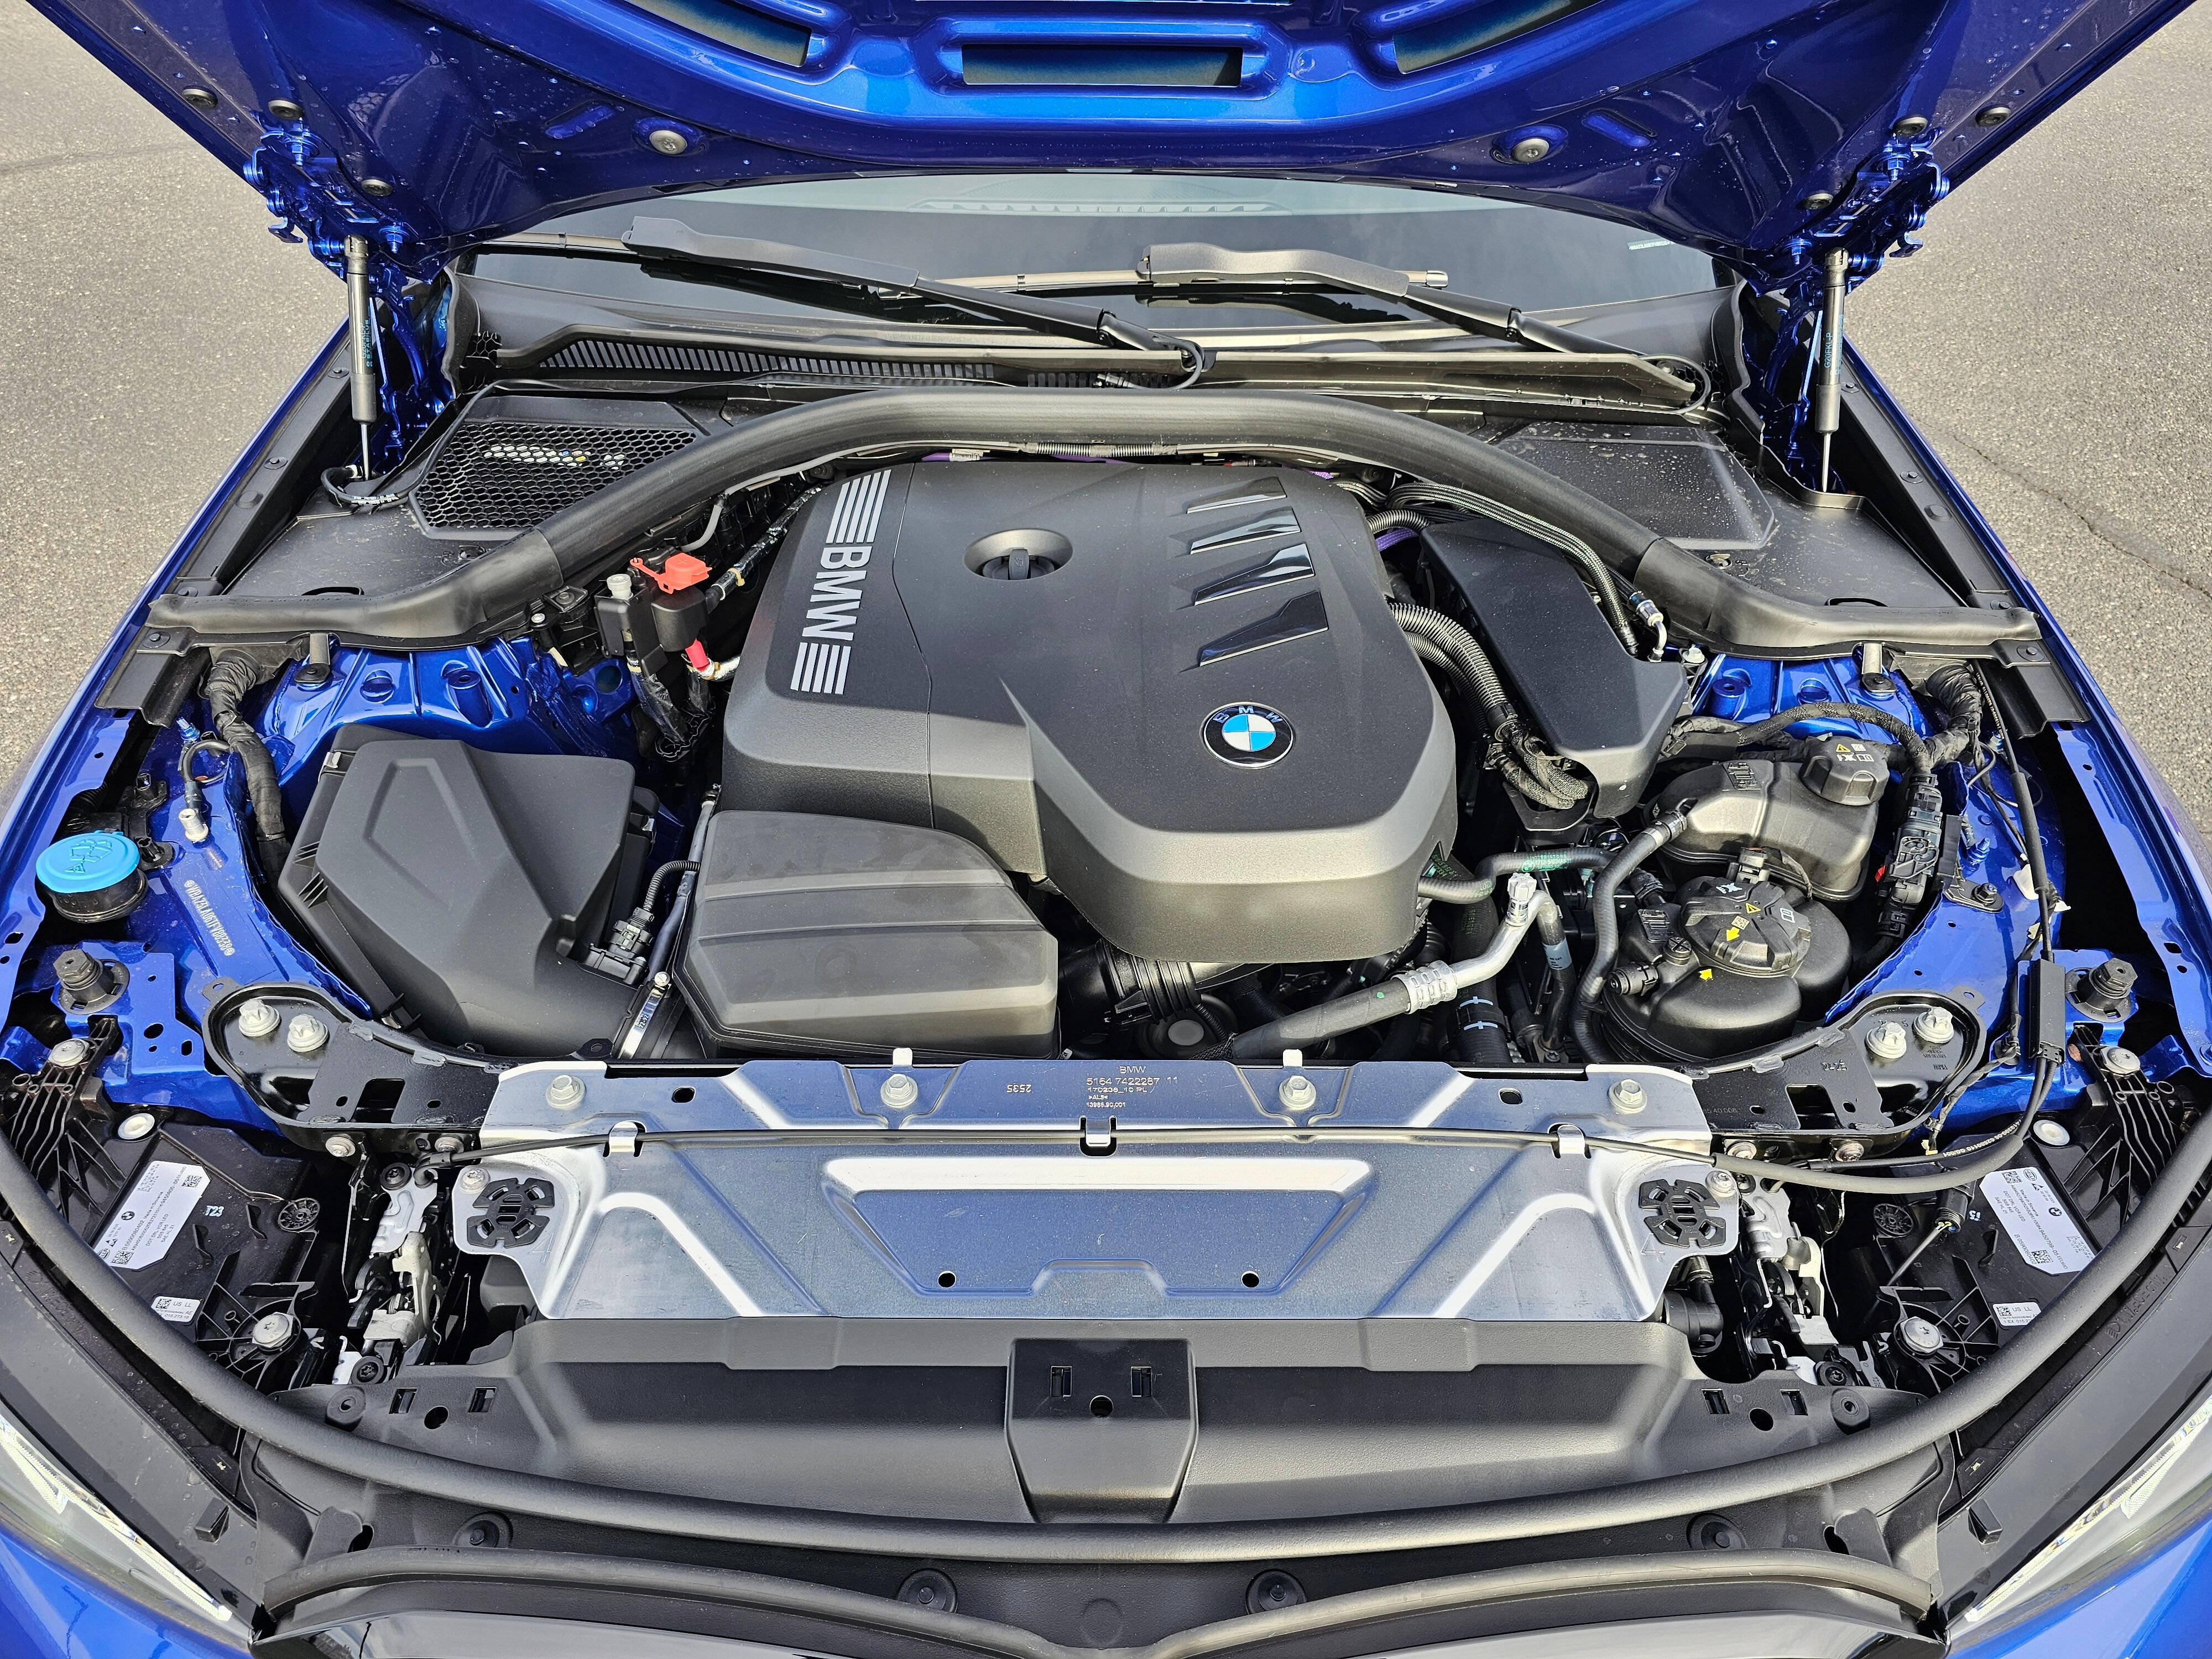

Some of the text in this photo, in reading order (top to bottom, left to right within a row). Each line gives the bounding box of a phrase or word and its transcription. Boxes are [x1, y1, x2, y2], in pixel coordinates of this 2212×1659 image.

[802, 546, 872, 640] BMW
[1213, 705, 1282, 724] BMW
[1006, 1084, 1032, 1093] 2535
[206, 1205, 224, 1217] T23
